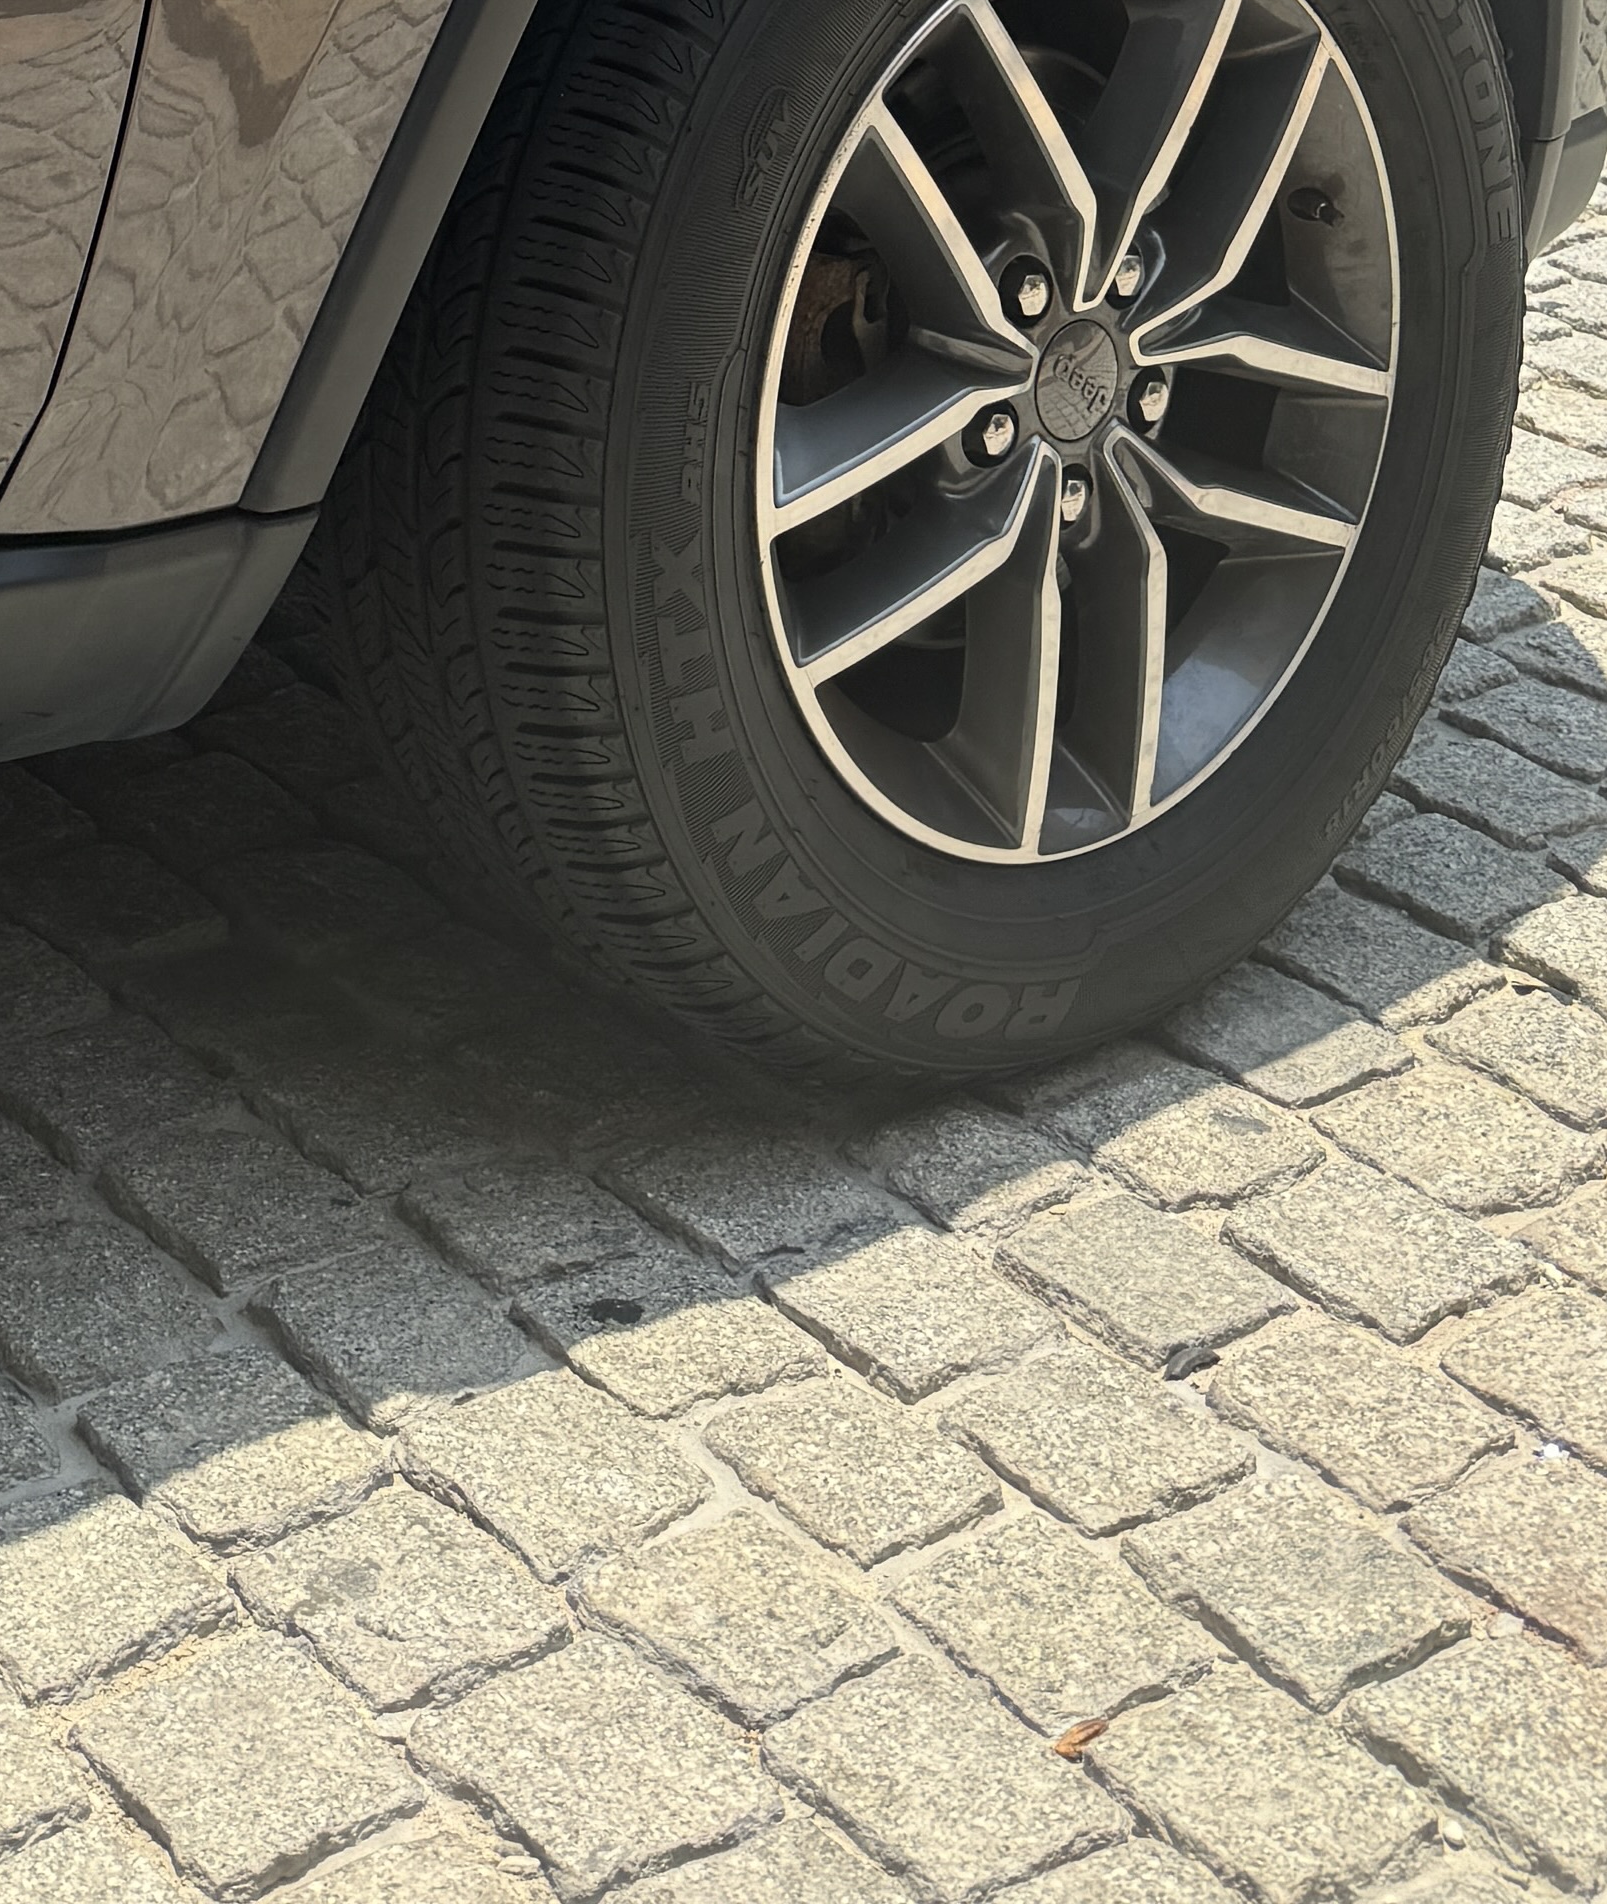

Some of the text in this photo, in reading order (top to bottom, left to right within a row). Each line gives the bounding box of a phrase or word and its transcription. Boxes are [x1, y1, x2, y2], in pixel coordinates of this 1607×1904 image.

[744, 97, 796, 209] SUV
[649, 532, 735, 767] HTX
[707, 796, 1080, 1041] ROADIAN
